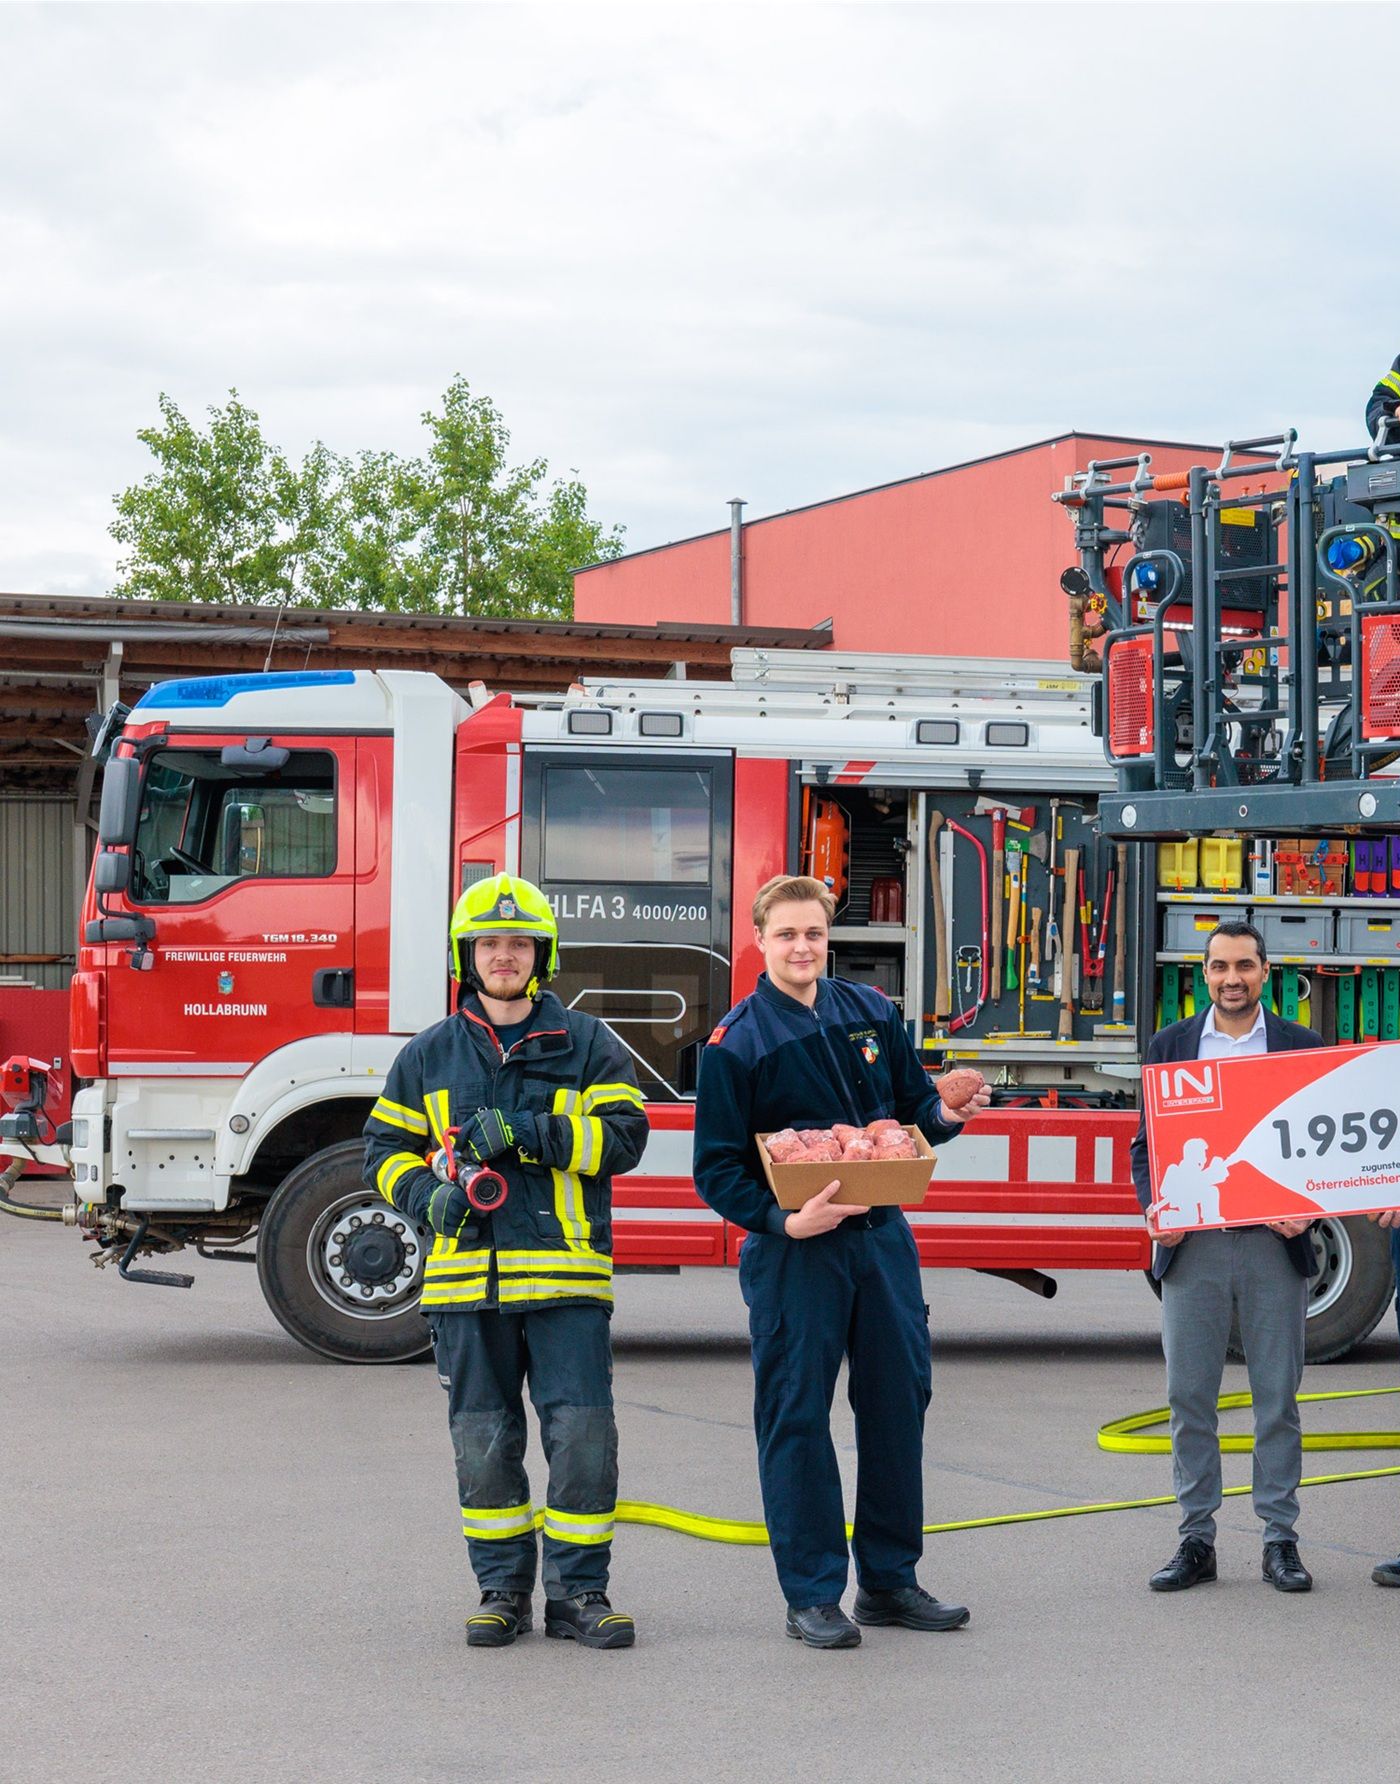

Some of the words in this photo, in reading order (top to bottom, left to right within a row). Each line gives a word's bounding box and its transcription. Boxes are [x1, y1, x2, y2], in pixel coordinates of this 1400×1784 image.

[545, 894, 606, 918] HLFA
[611, 895, 625, 920] 3
[632, 904, 707, 921] 4000/200
[262, 933, 288, 943] TGM
[291, 933, 337, 943] 18.340
[165, 952, 225, 962] FREIWILLIGE
[228, 952, 287, 963] FEUERWEHR
[1343, 980, 1351, 992] C
[1366, 977, 1374, 989] C
[1387, 980, 1395, 992] C
[184, 1003, 267, 1016] HOLLABRUNN
[1160, 1065, 1213, 1099] IN
